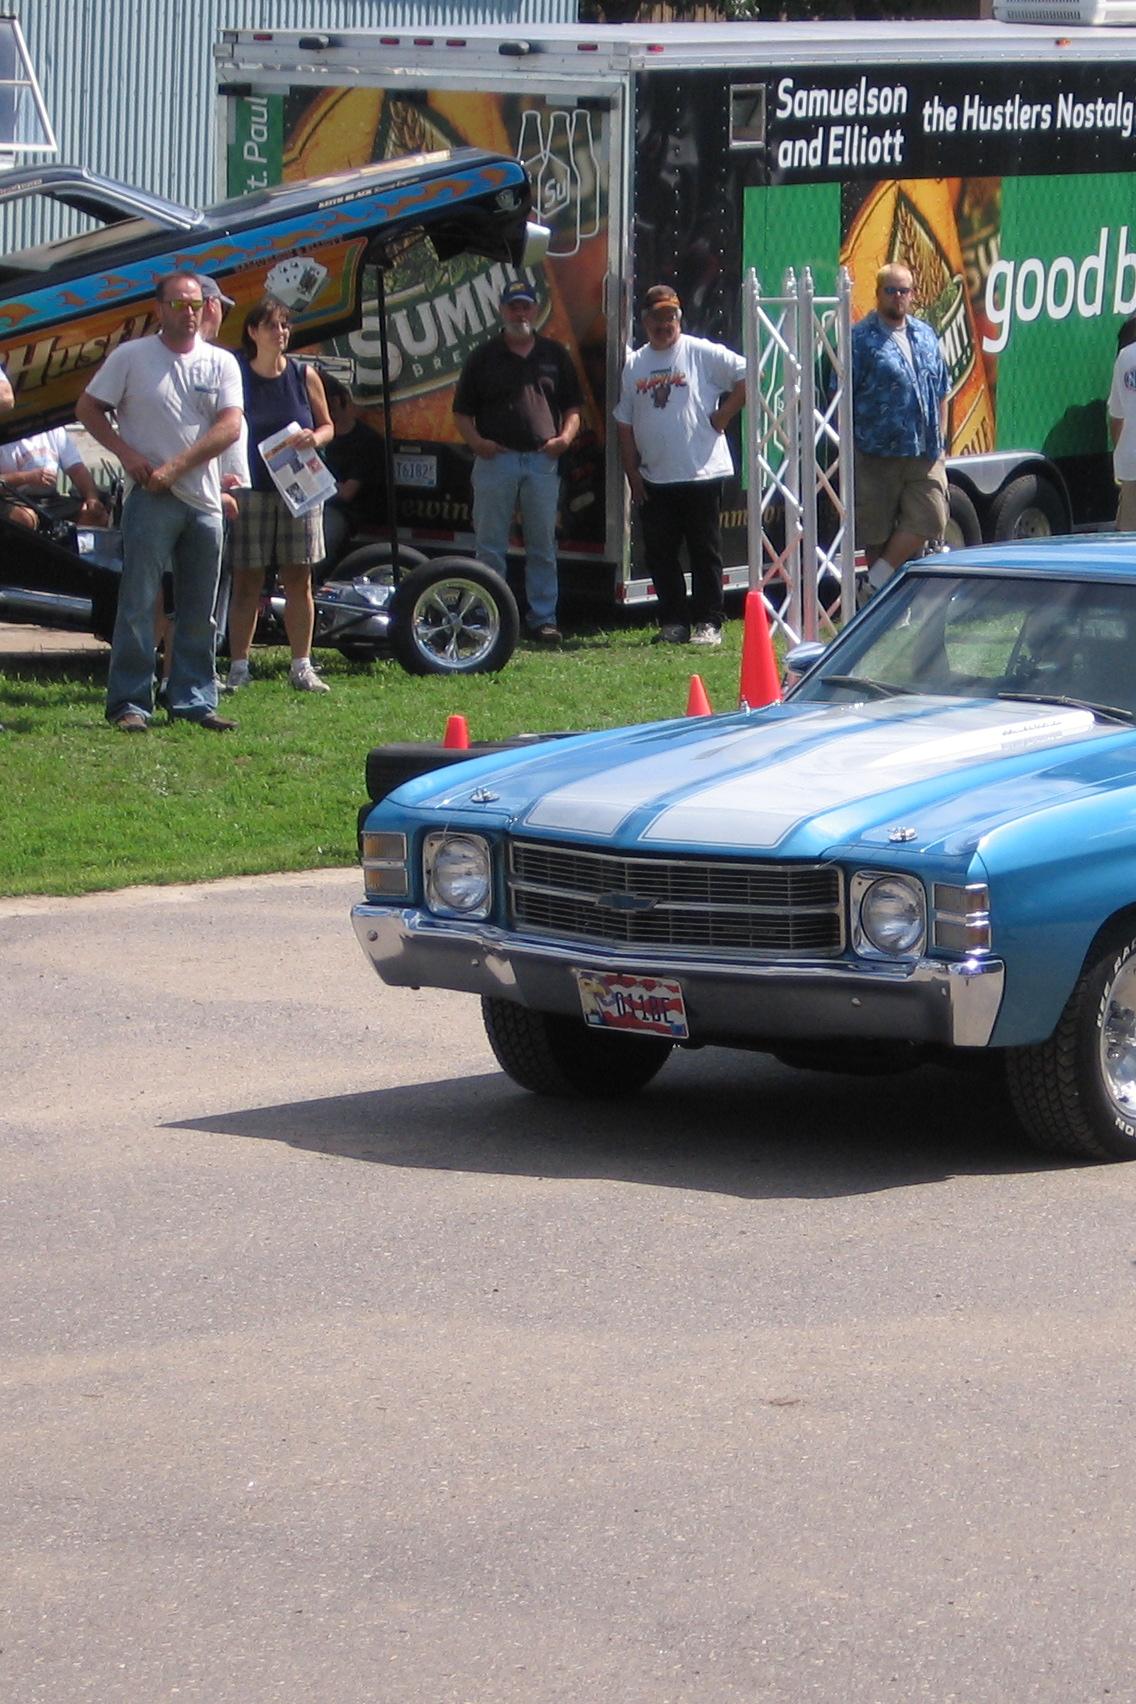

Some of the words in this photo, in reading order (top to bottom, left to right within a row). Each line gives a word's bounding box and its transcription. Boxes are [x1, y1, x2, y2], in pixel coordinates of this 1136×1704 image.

[776, 77, 908, 118] Samuelson
[923, 96, 957, 133] the
[963, 95, 1053, 132] Hustlers
[243, 96, 269, 161] Paul
[778, 131, 823, 168] and
[828, 125, 905, 167] Elliott
[244, 170, 269, 197] t.
[982, 226, 1110, 353] good
